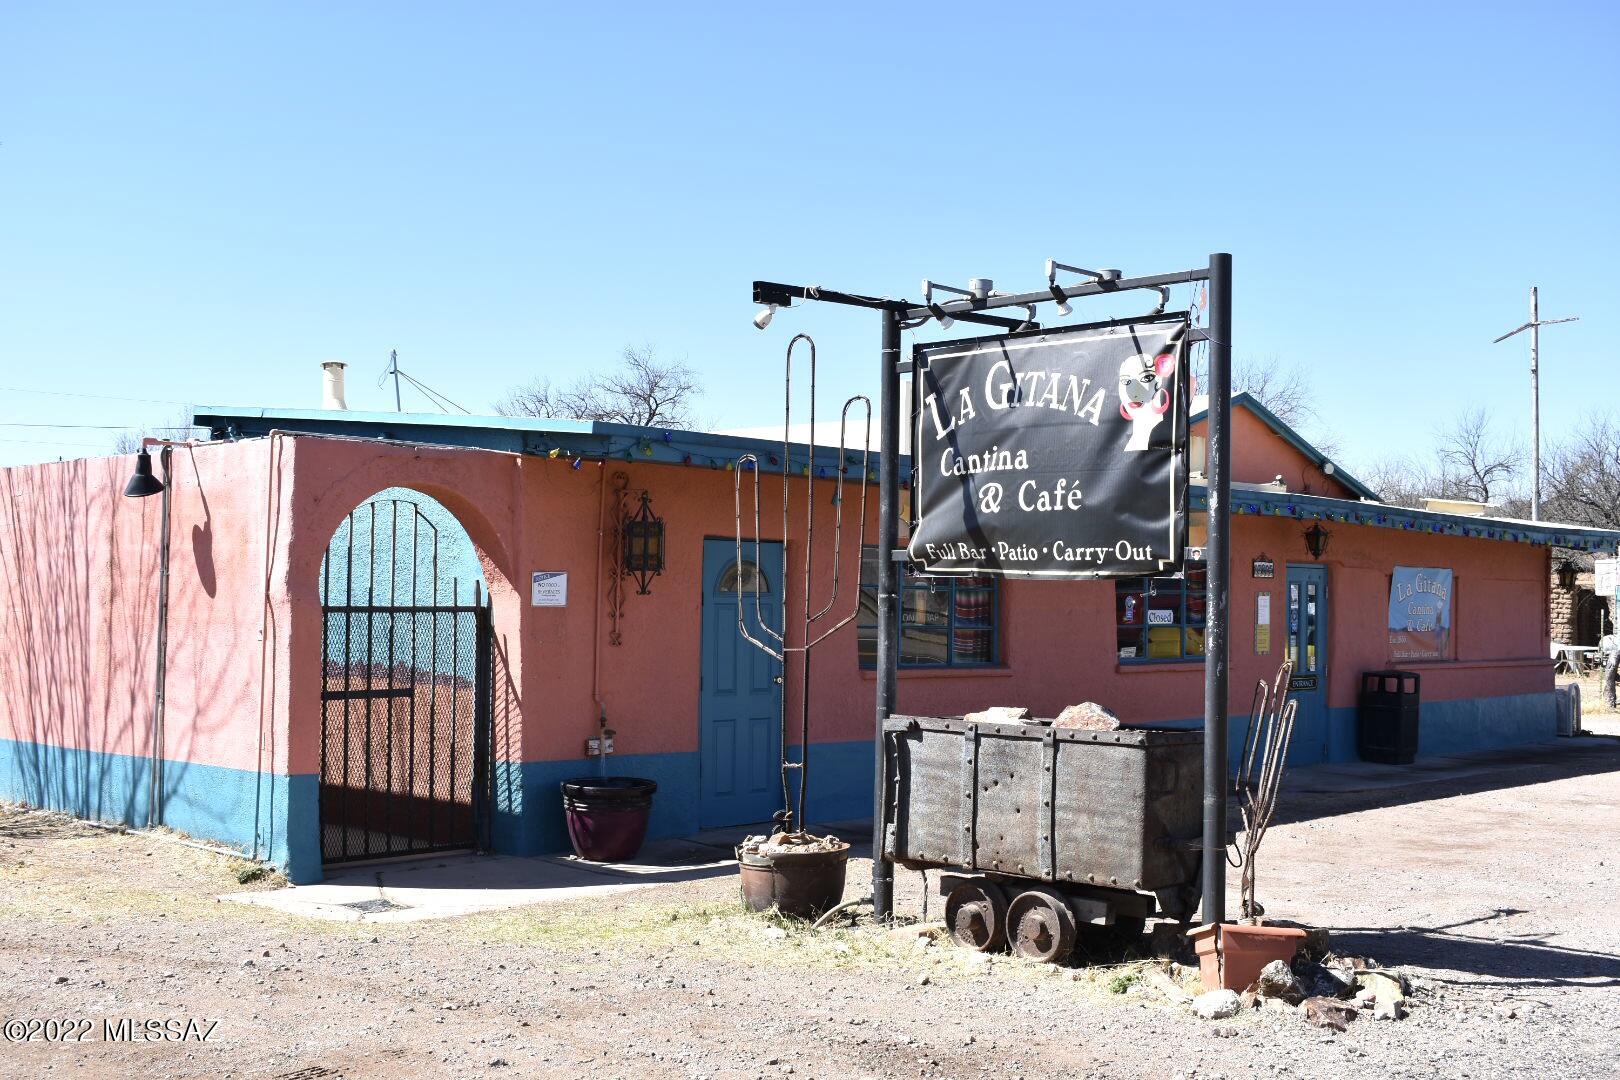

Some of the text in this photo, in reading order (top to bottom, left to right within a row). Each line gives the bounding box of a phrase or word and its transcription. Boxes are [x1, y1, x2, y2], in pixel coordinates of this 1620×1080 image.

[984, 360, 1106, 426] GITANA
[940, 446, 1029, 477] Cantina
[978, 478, 1082, 513] & Café
[925, 540, 1153, 564] Full Bar Patio Carry-Out
[1396, 573, 1447, 602] La Gitana
[1148, 612, 1172, 623] Closed
[1292, 679, 1315, 689] ENTRANCE
